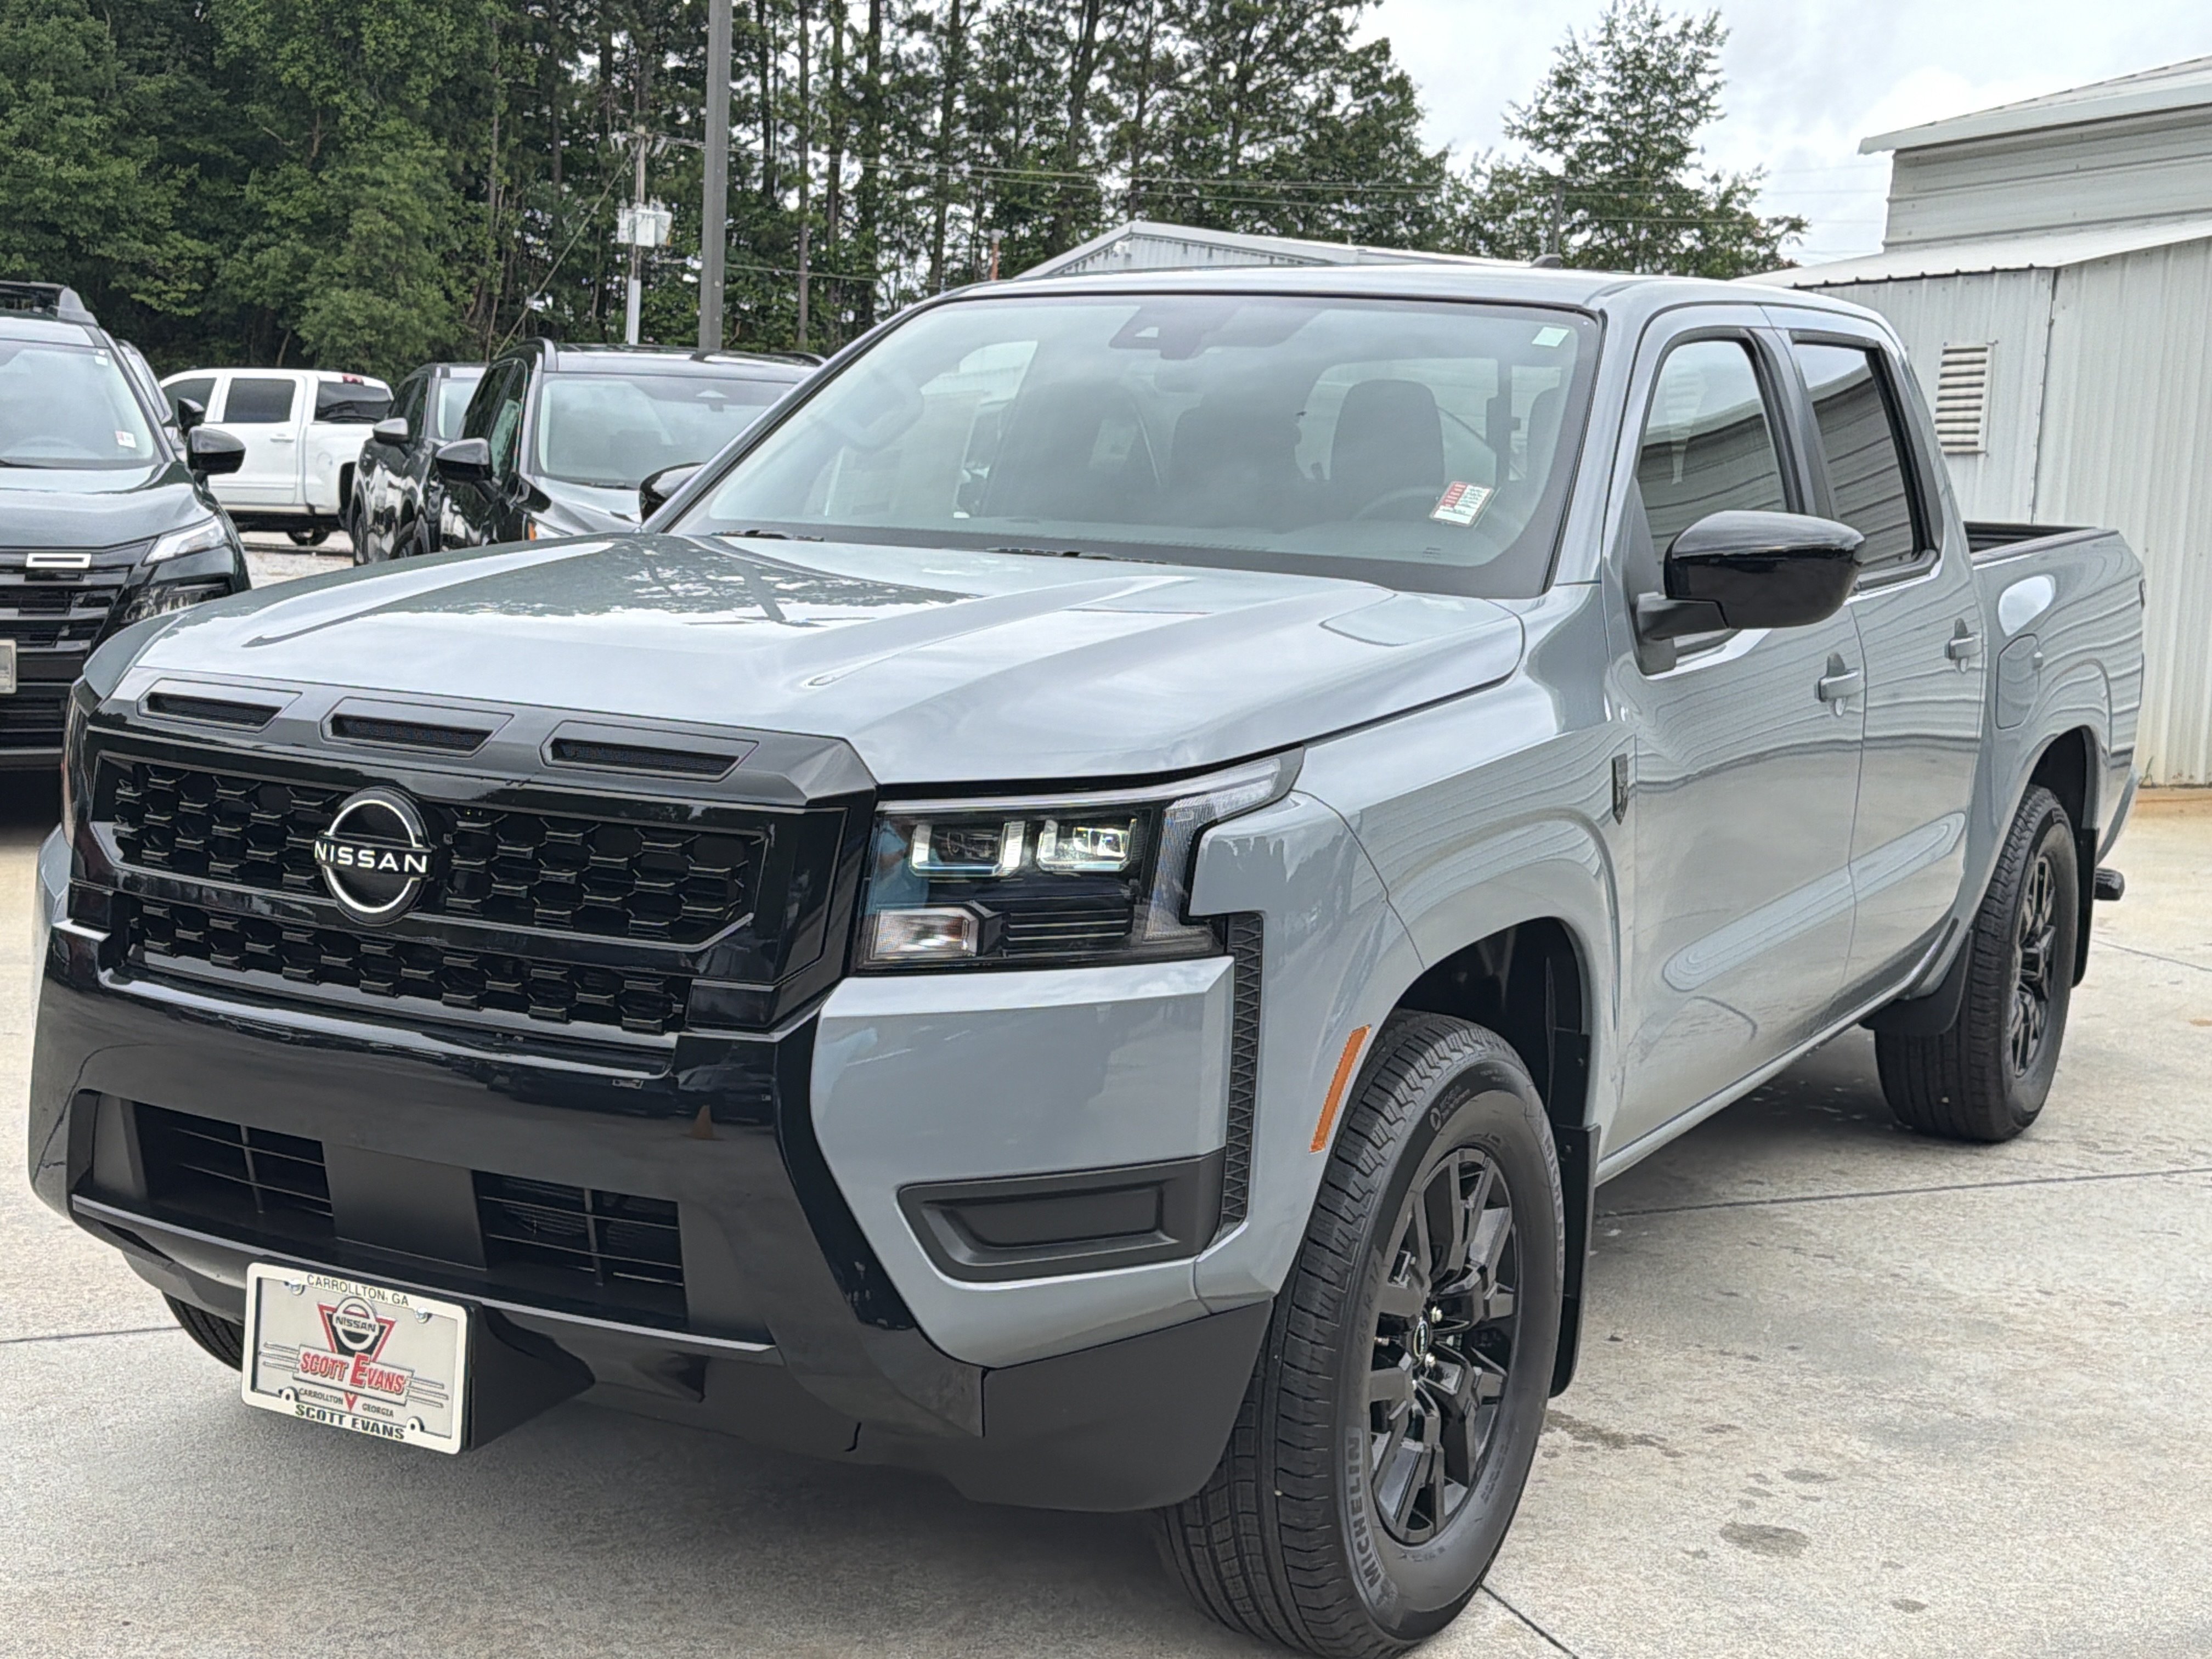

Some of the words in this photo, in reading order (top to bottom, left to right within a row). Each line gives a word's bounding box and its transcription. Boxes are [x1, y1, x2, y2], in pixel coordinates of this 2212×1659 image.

[314, 840, 427, 873] NISSAN
[392, 1294, 409, 1306] GA
[335, 1316, 377, 1332] NISSAN
[300, 1351, 349, 1381] SCOTT
[349, 1352, 406, 1395] EVANS
[298, 1387, 344, 1405] CARROLLTON
[295, 1403, 347, 1425] SCOTT
[351, 1417, 405, 1440] EVANS
[362, 1402, 394, 1418] GEORGIA
[1347, 1435, 1382, 1589] MICHELIN
